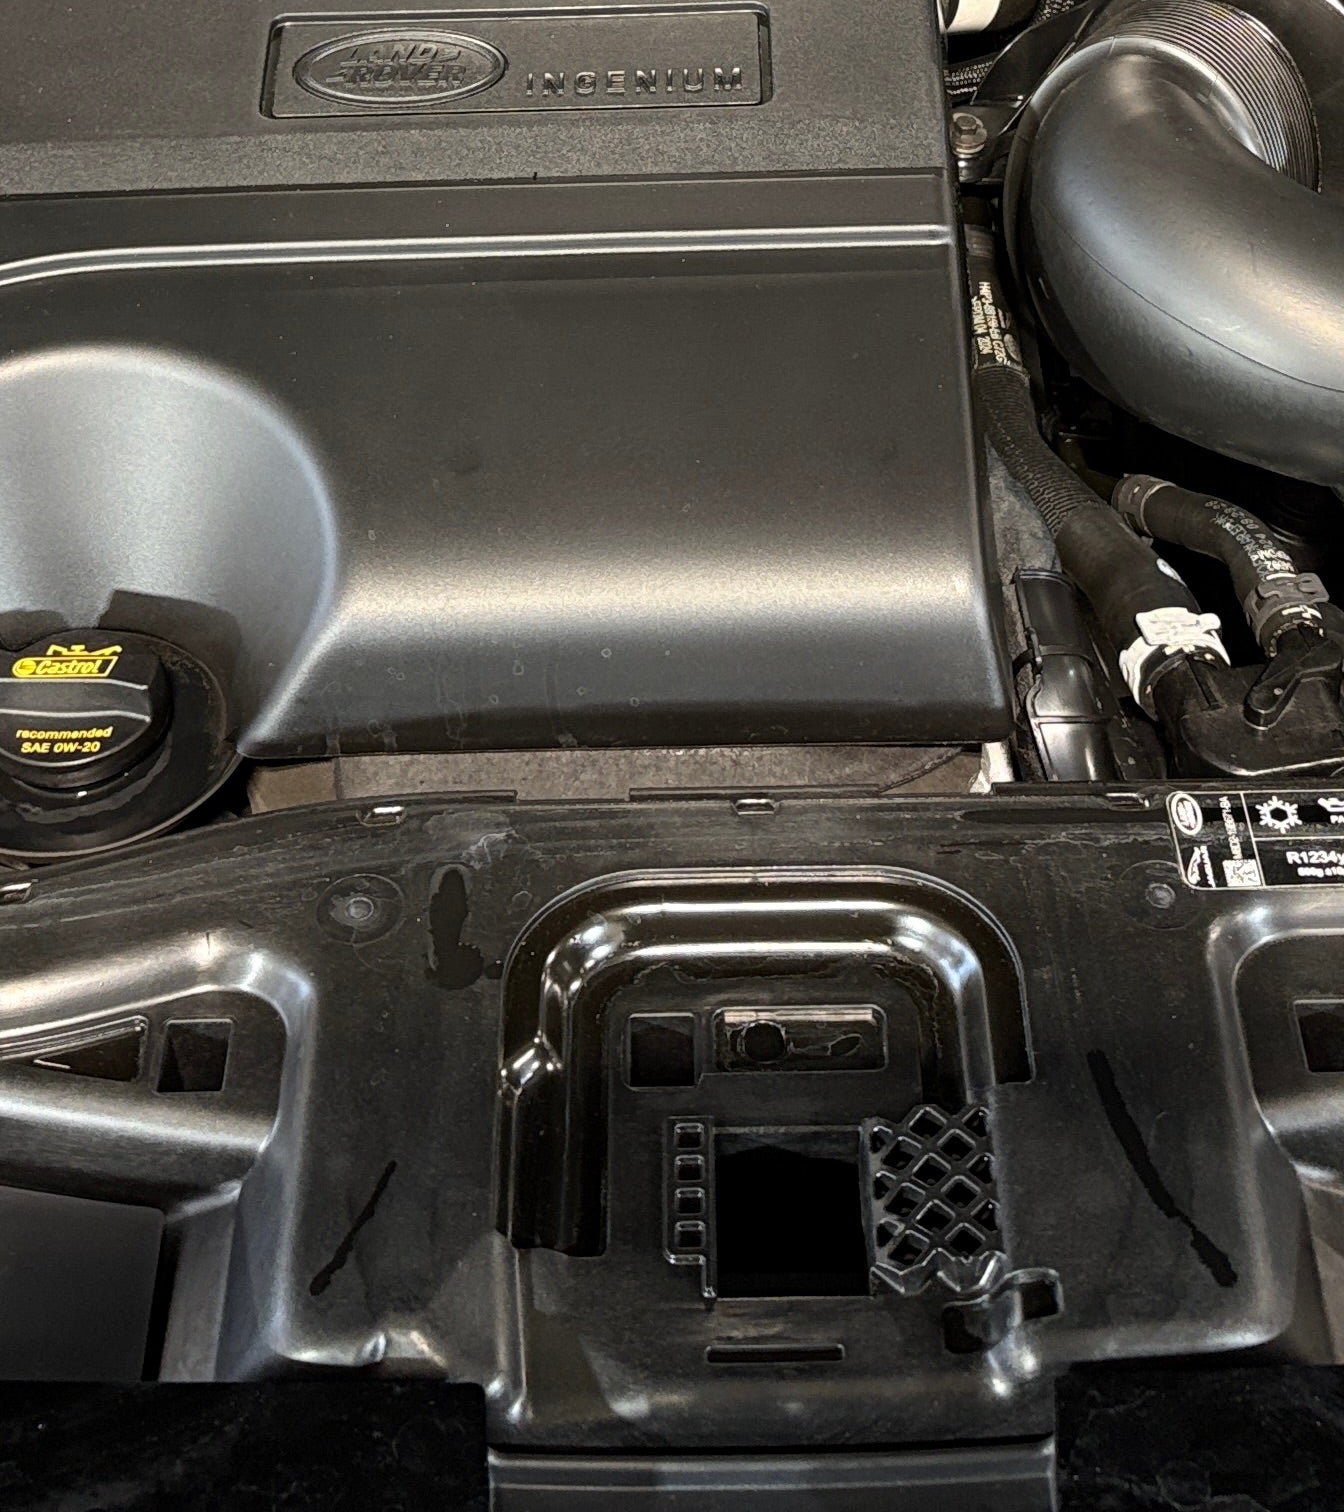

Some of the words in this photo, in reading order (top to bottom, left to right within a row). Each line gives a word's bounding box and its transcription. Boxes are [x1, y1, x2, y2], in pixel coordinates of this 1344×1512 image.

[342, 64, 468, 89] ROVER
[526, 67, 743, 96] INGENIUM
[36, 660, 103, 675] Castrol
[16, 726, 114, 740] recommended
[21, 742, 51, 754] SAE
[53, 741, 101, 754] 0W-20
